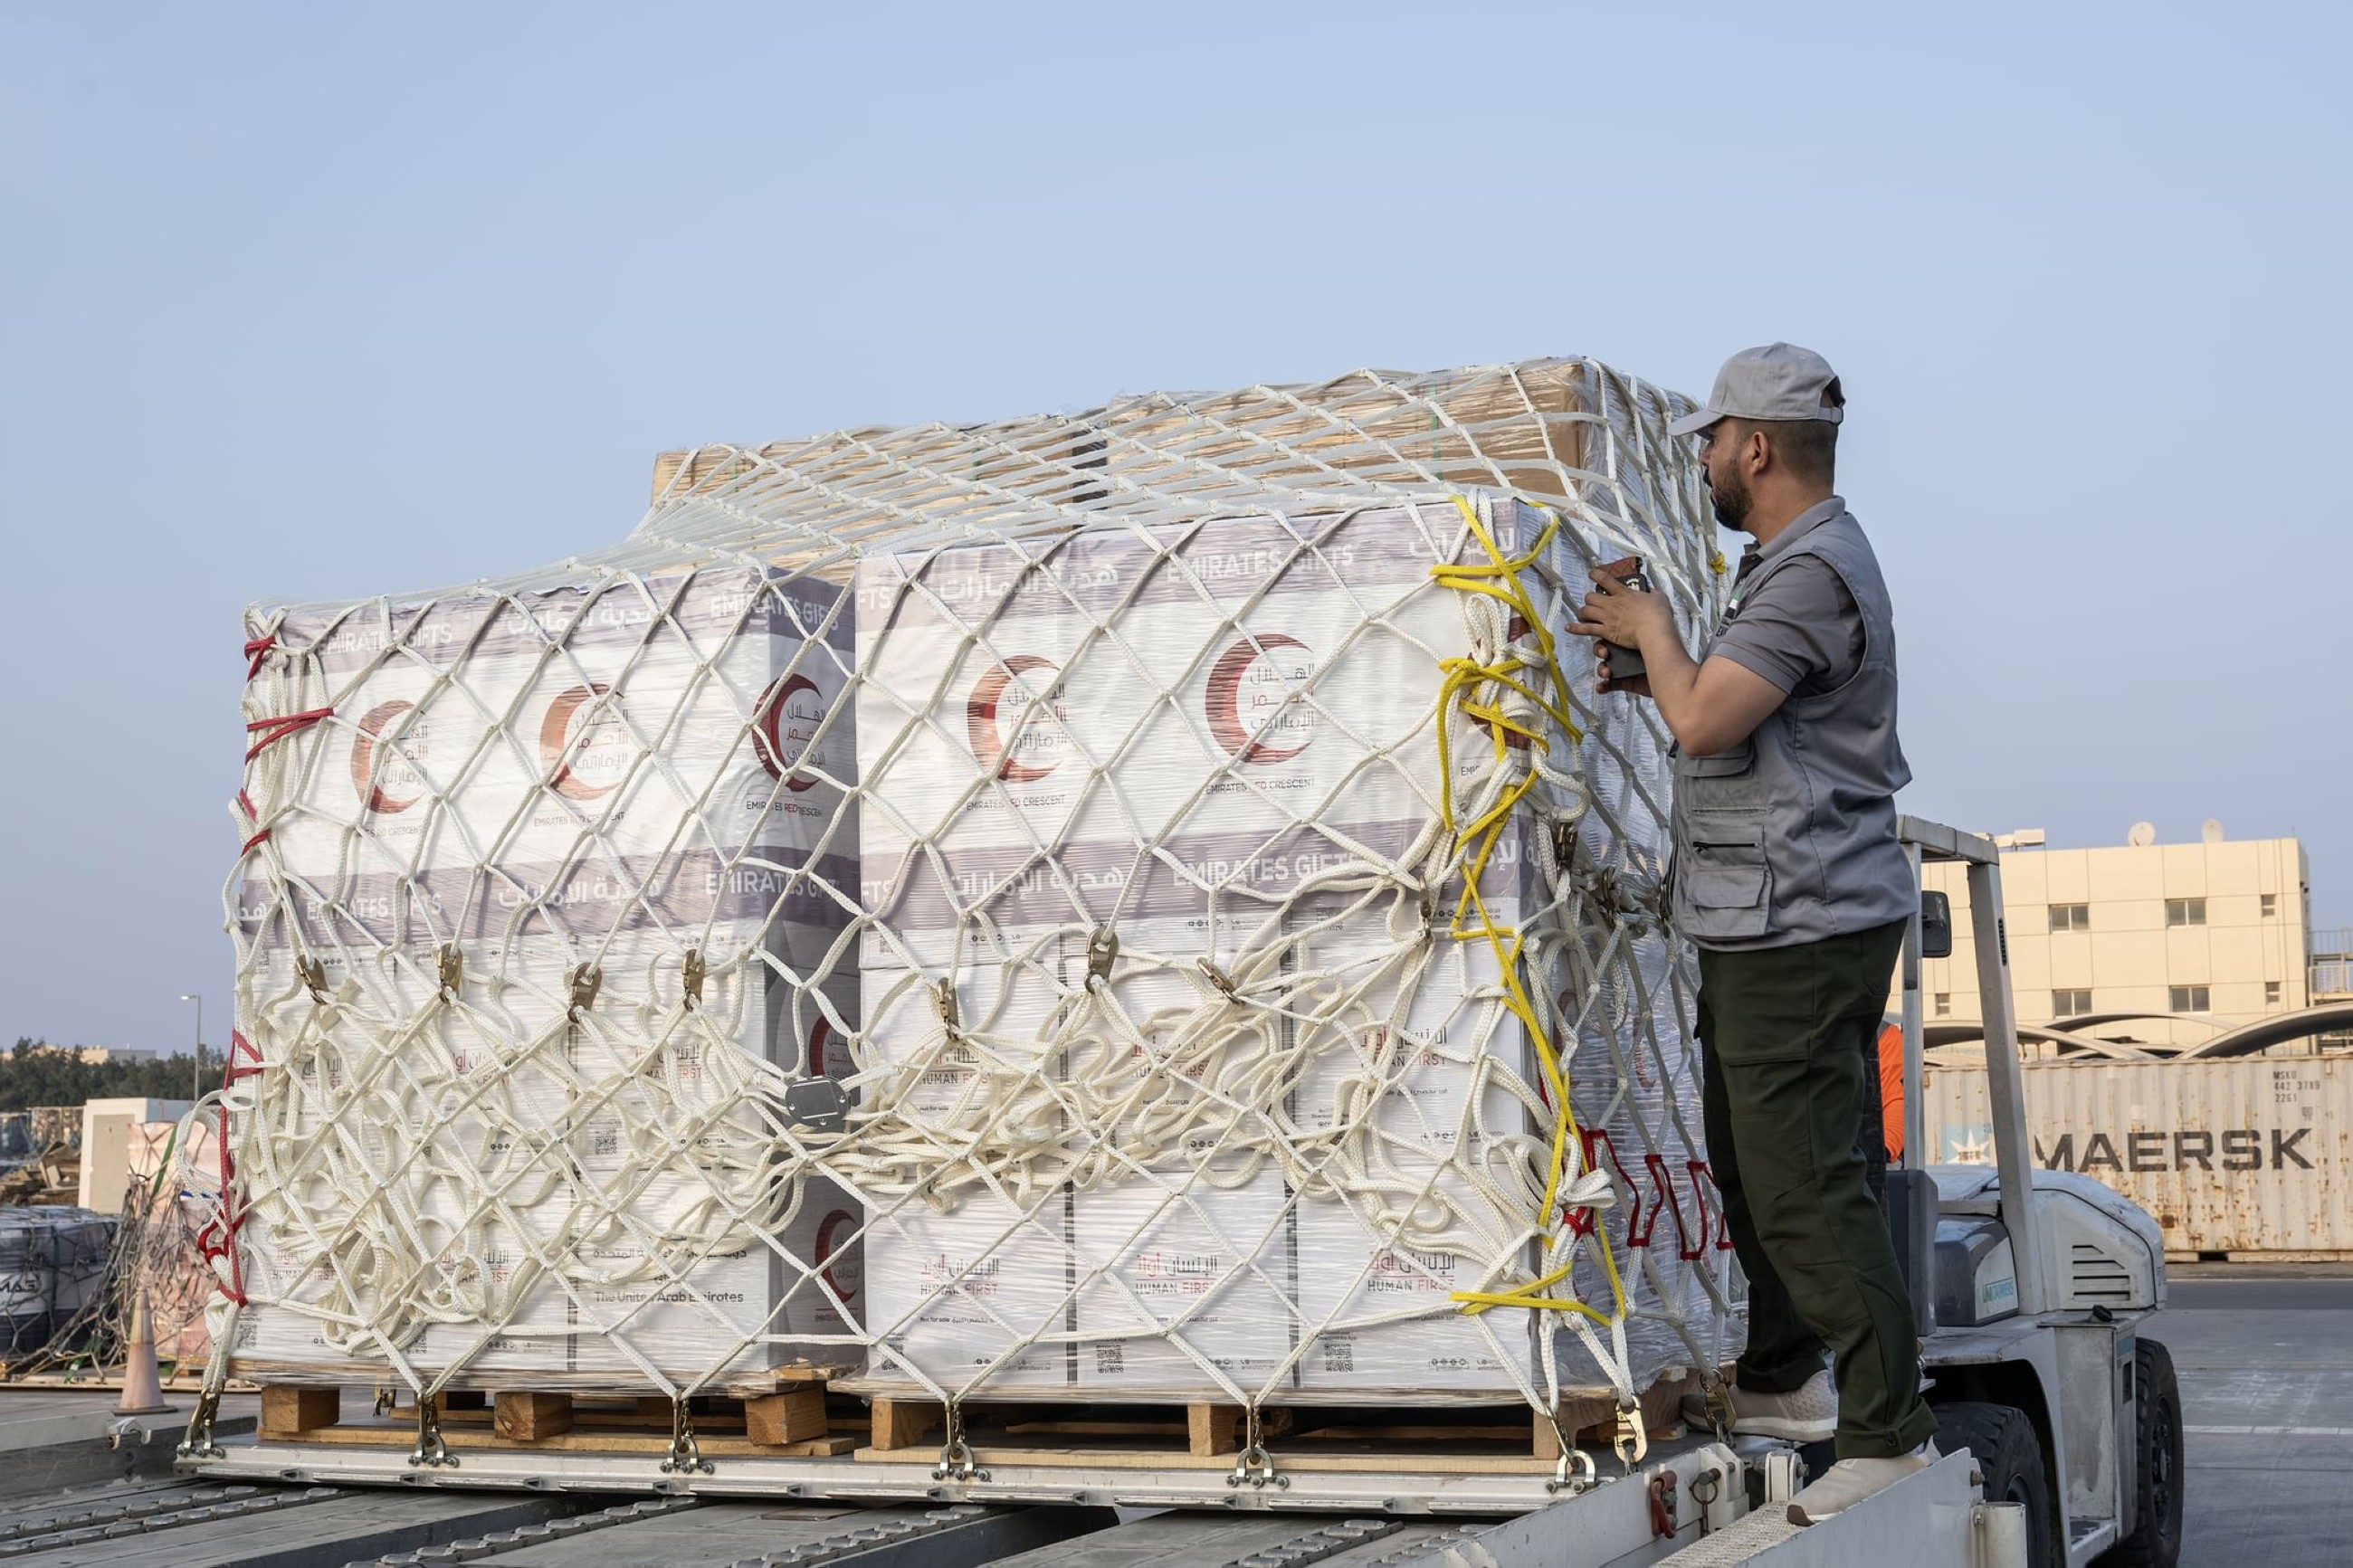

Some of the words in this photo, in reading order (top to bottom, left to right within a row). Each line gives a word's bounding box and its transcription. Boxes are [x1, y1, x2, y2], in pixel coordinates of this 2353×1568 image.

[2034, 1128, 2314, 1173] MAERSK
[1183, 1281, 1214, 1294] FIRS
[1367, 1280, 1412, 1292] HUMAN
[595, 1291, 614, 1303] The
[617, 1291, 655, 1303] Unite
[657, 1291, 686, 1303] Arab
[689, 1291, 744, 1303] Eirates
